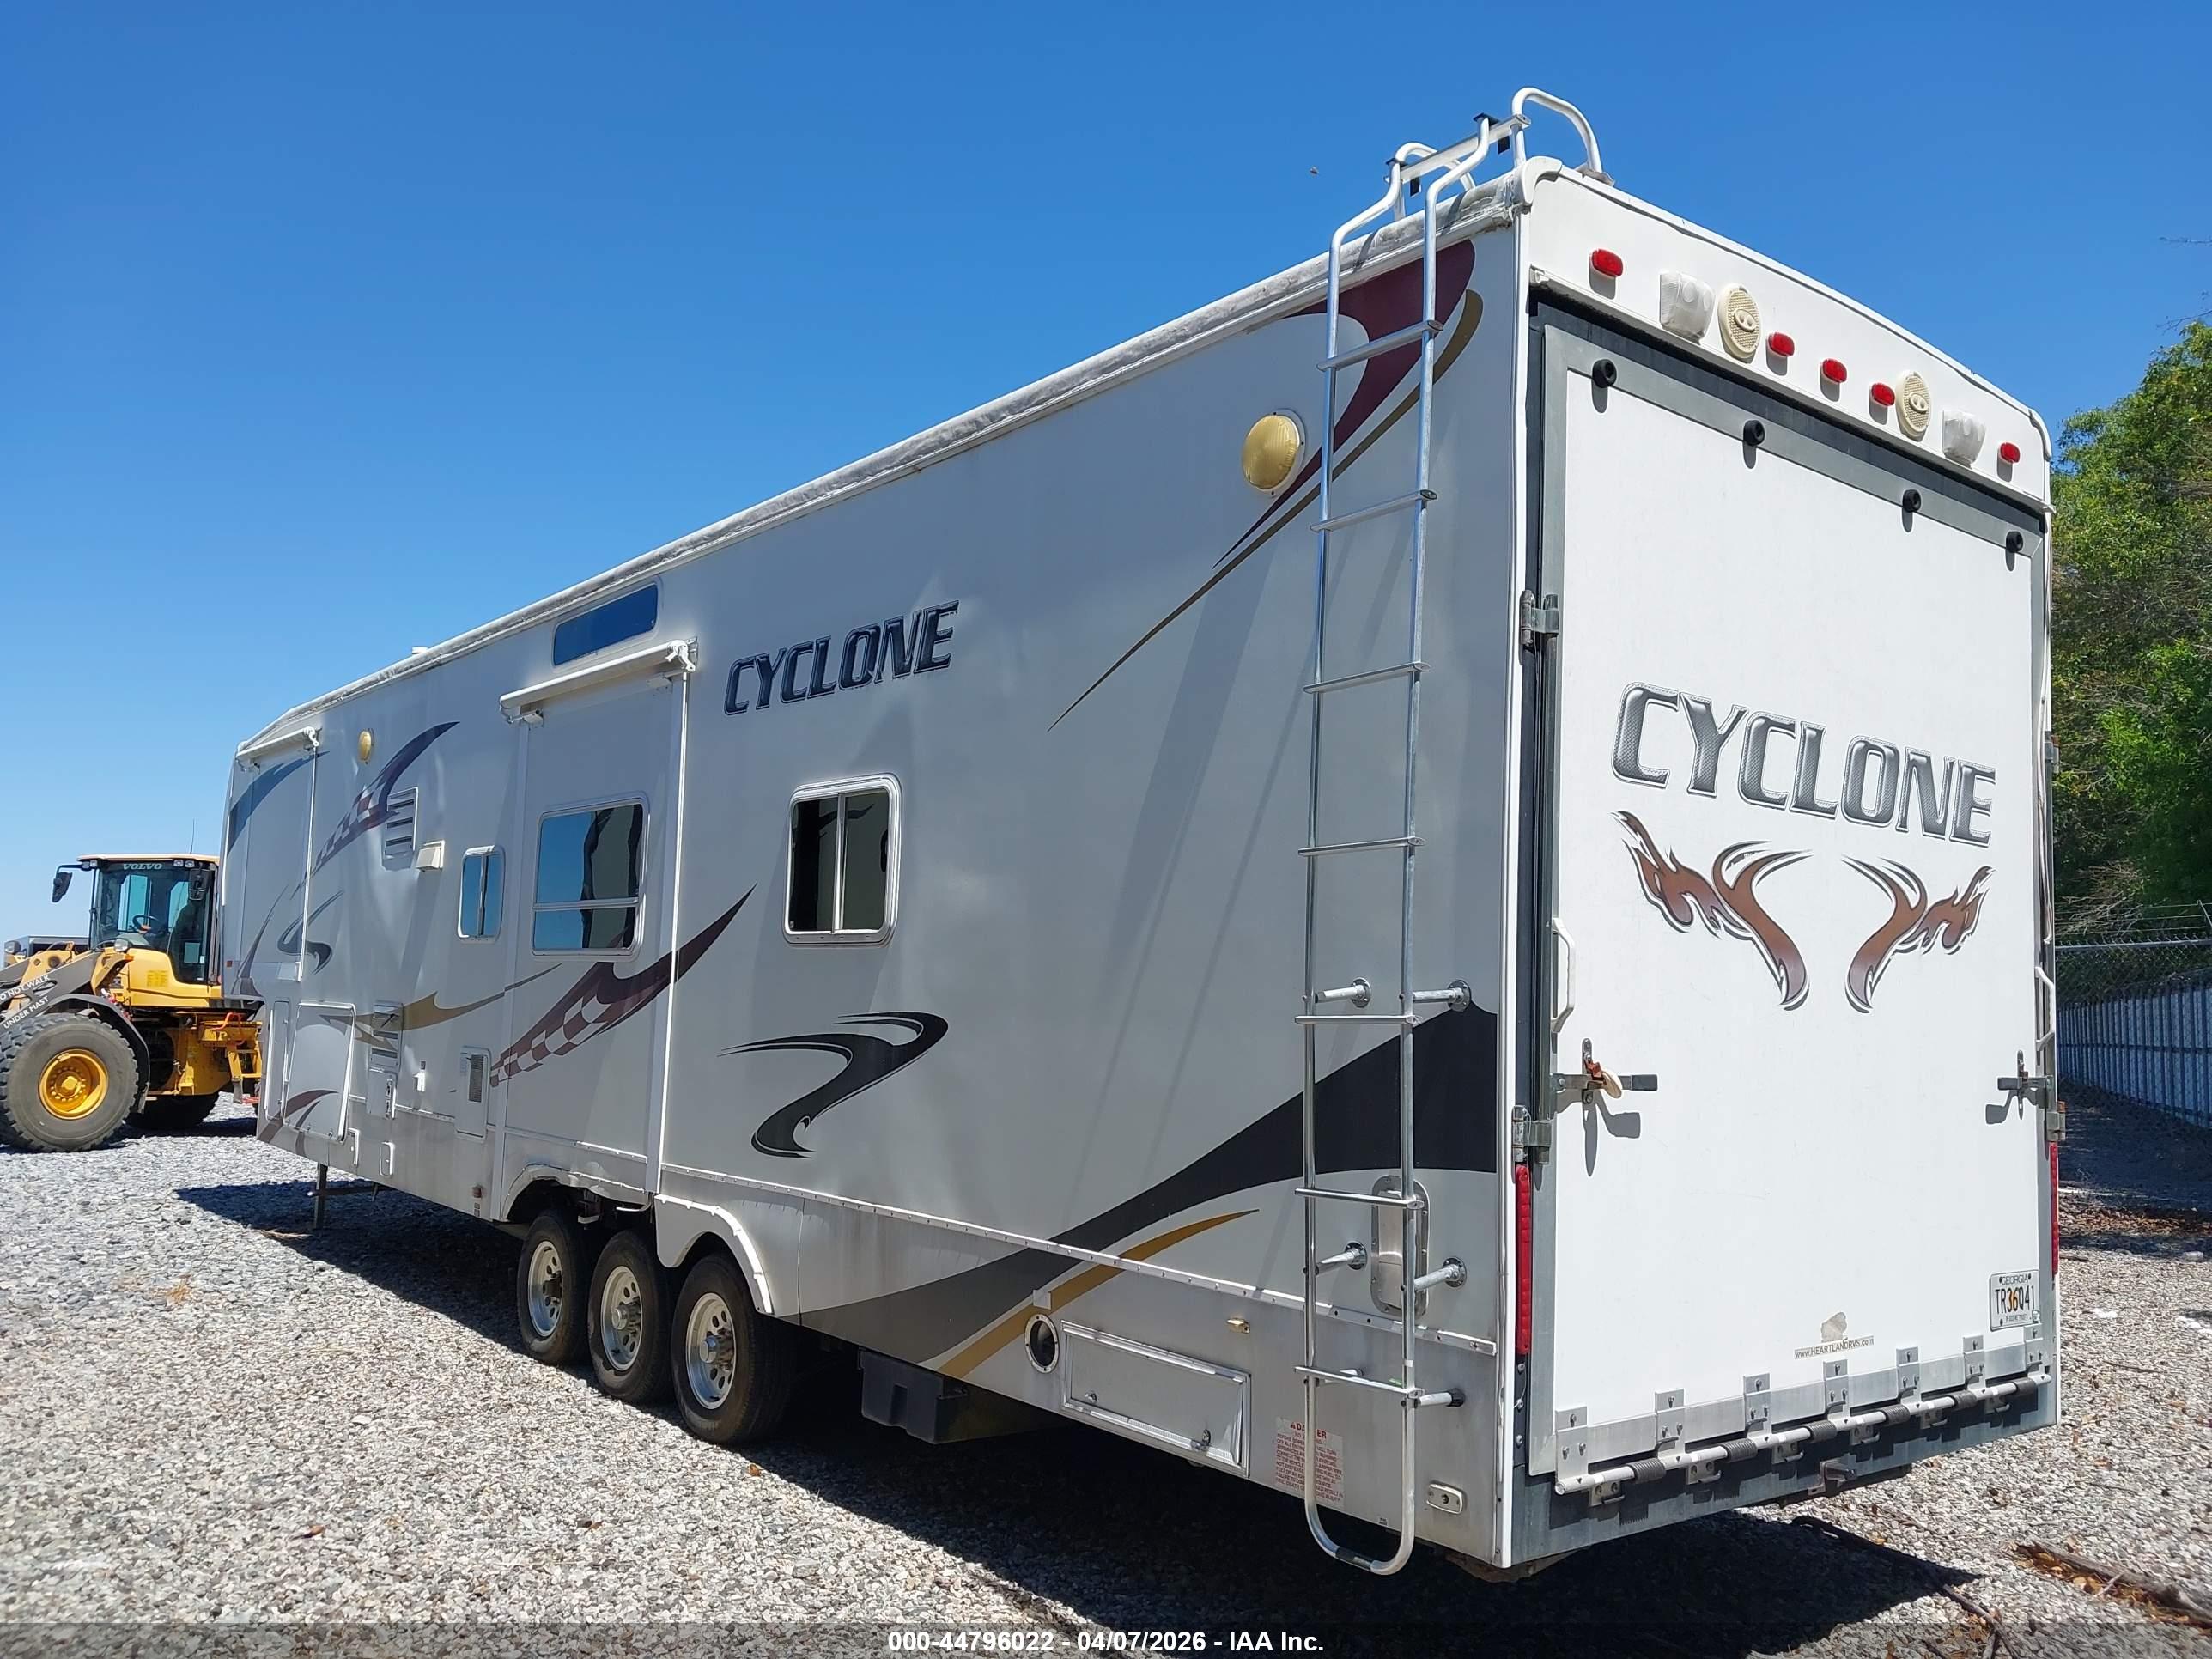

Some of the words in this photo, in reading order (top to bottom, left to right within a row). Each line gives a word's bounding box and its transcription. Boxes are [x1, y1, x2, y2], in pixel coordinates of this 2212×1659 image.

[724, 600, 960, 715] CYCLONE
[1611, 680, 1996, 848] CYCLONE
[27, 975, 49, 988] WALK
[3, 1009, 29, 1029] UNDER
[28, 995, 49, 1012] MAST
[1795, 1337, 1874, 1358] www.HEARTLANDRVS.com
[1297, 1422, 1327, 1438] DAER
